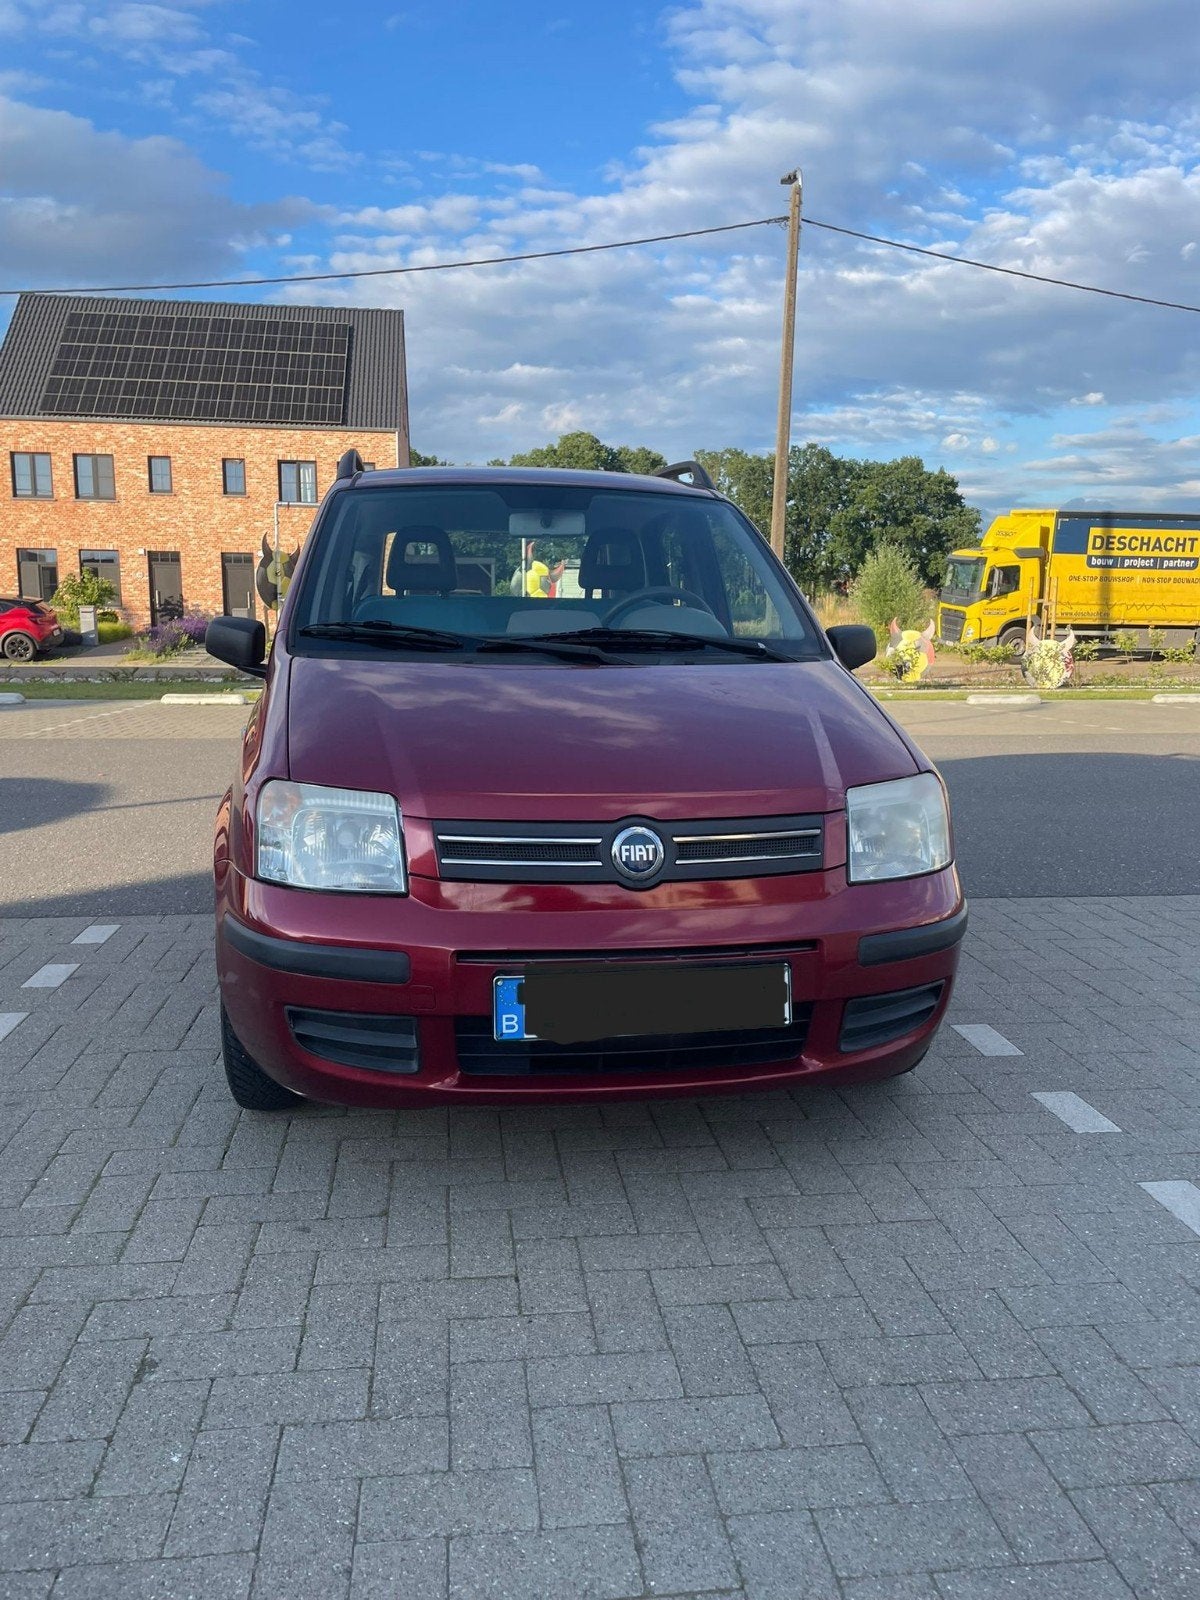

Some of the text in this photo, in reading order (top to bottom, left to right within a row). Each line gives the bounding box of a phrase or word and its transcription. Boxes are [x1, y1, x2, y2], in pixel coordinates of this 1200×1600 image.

[1092, 535, 1198, 552] DESCHACHT
[1091, 557, 1195, 568] bouw project partner
[621, 844, 655, 862] FIAT
[502, 1014, 519, 1034] B
